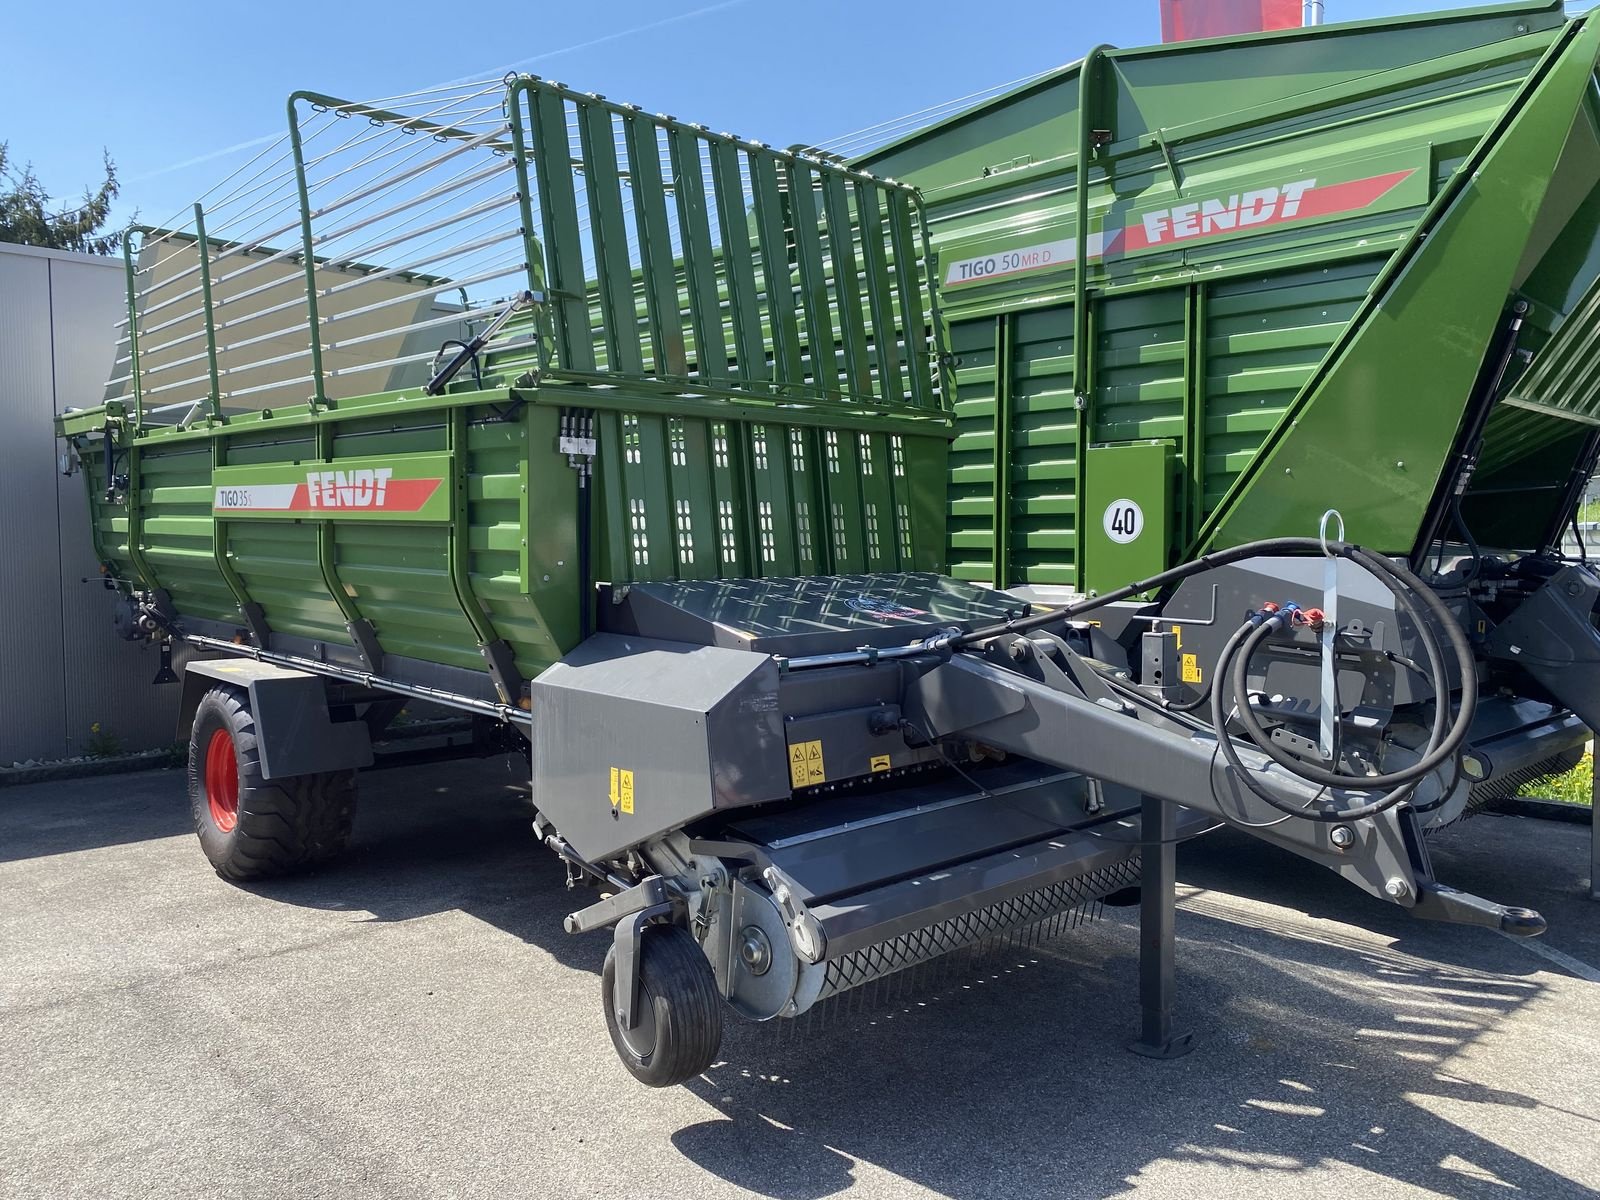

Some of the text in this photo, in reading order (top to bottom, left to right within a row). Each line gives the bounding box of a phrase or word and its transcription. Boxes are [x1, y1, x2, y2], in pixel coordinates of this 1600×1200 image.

[1142, 178, 1317, 244] FENDT
[959, 258, 996, 279] TIGO
[220, 490, 238, 506] TIGO
[306, 468, 393, 507] FENDT
[1111, 507, 1135, 535] 40
